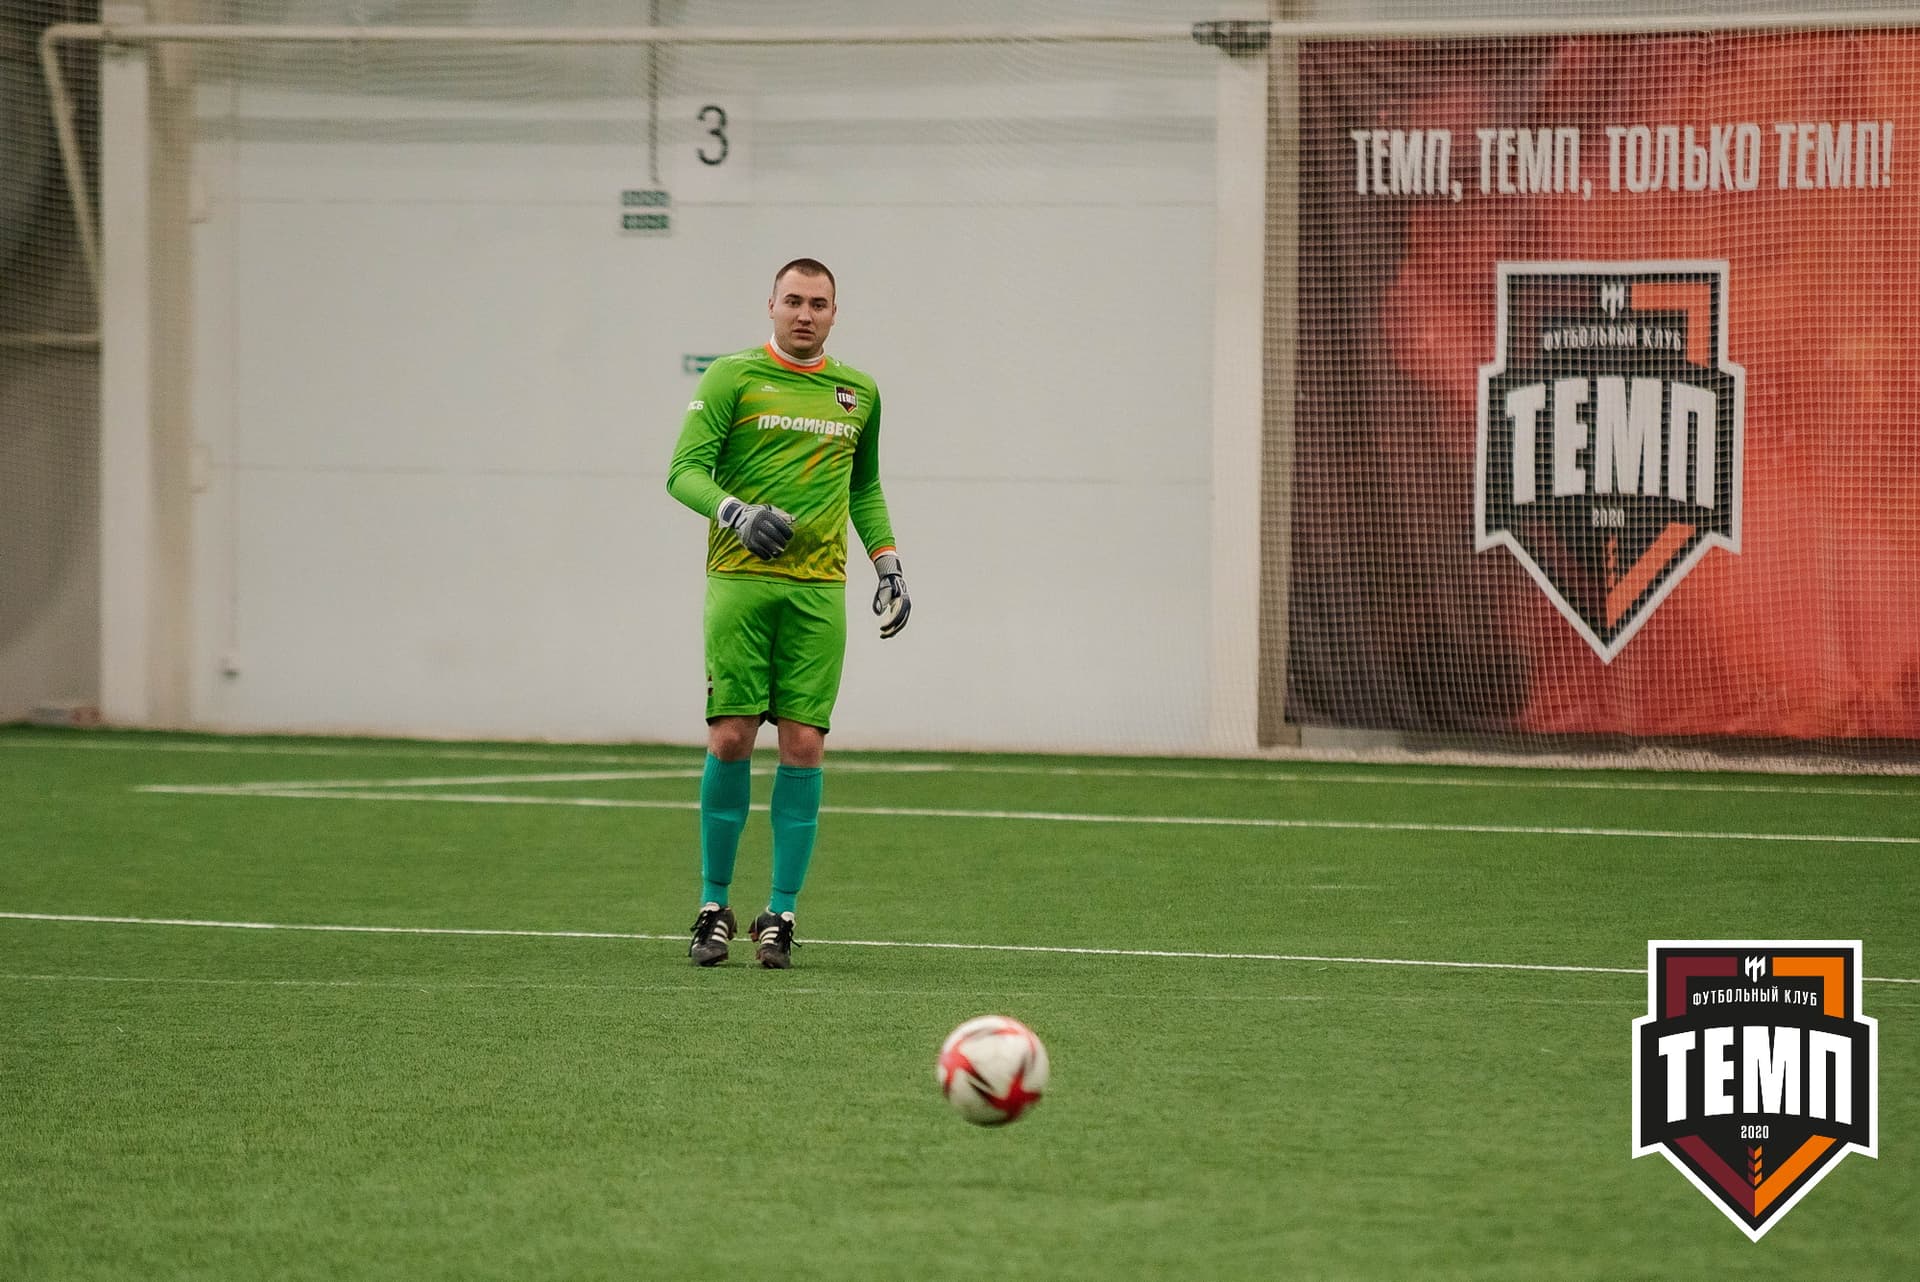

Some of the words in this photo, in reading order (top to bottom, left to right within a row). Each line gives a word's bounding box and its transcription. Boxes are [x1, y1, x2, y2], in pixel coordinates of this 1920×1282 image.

[697, 105, 728, 166] 3
[1351, 129, 1463, 201] ТЕМП,
[1477, 128, 1592, 200] ТЕМП,
[1606, 124, 1760, 192] ТОЛЬКО
[1776, 121, 1894, 189] ТЕМП!
[1544, 322, 1637, 351] ФУТБОЛЬНЫЙ
[1643, 326, 1681, 351] КЛУБ
[758, 415, 857, 439] ПРОДИНВЕСТ
[1506, 376, 1716, 510] ТЕМП
[1592, 508, 1625, 528] 2020
